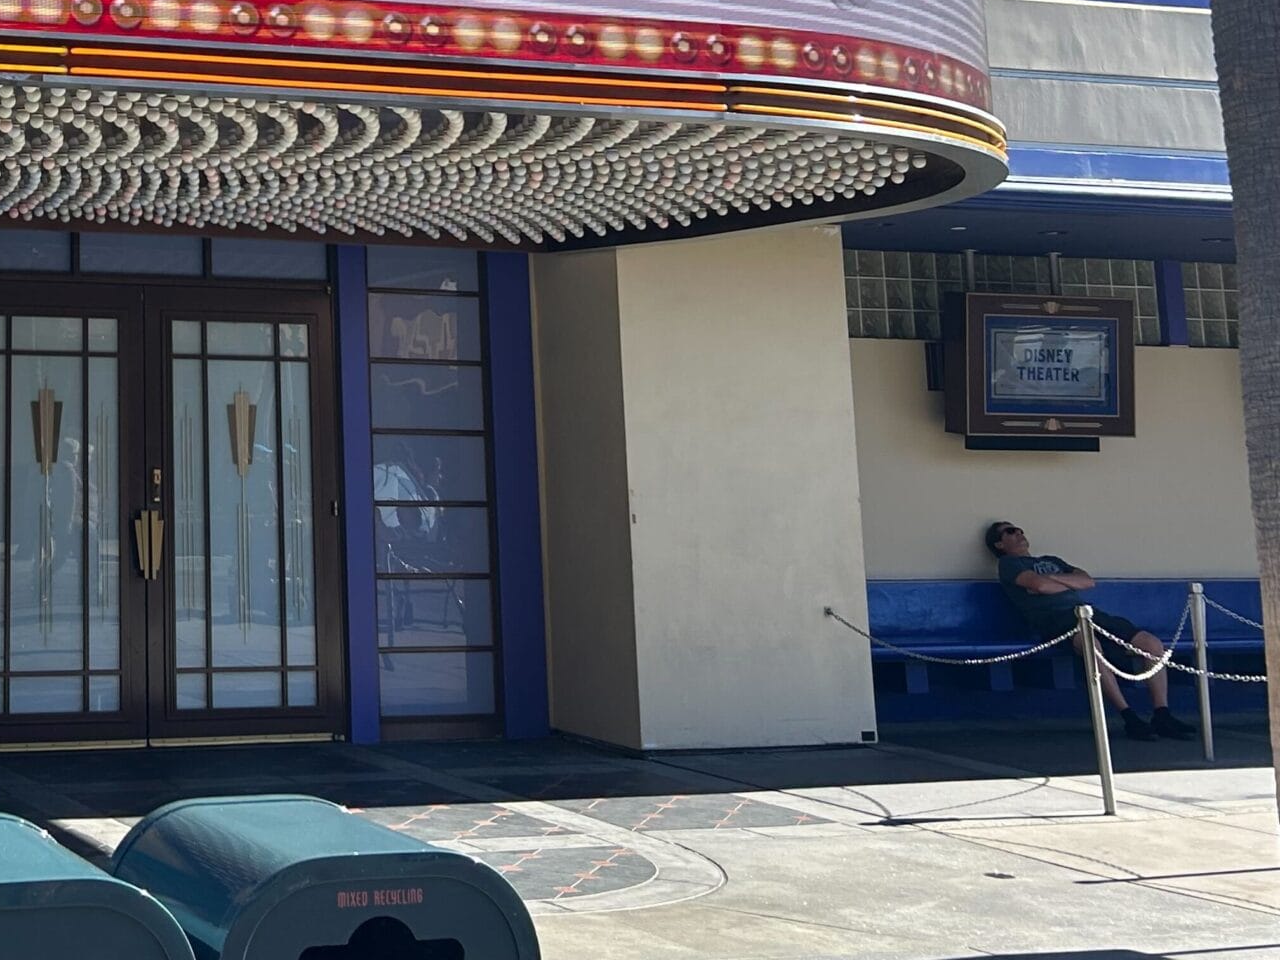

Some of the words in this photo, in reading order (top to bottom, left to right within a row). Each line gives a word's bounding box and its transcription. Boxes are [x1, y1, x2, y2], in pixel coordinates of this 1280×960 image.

[1023, 348, 1072, 364] DISNEY
[1017, 366, 1080, 382] THEATER
[337, 891, 368, 908] MIXED
[374, 888, 423, 906] RECYCLING
